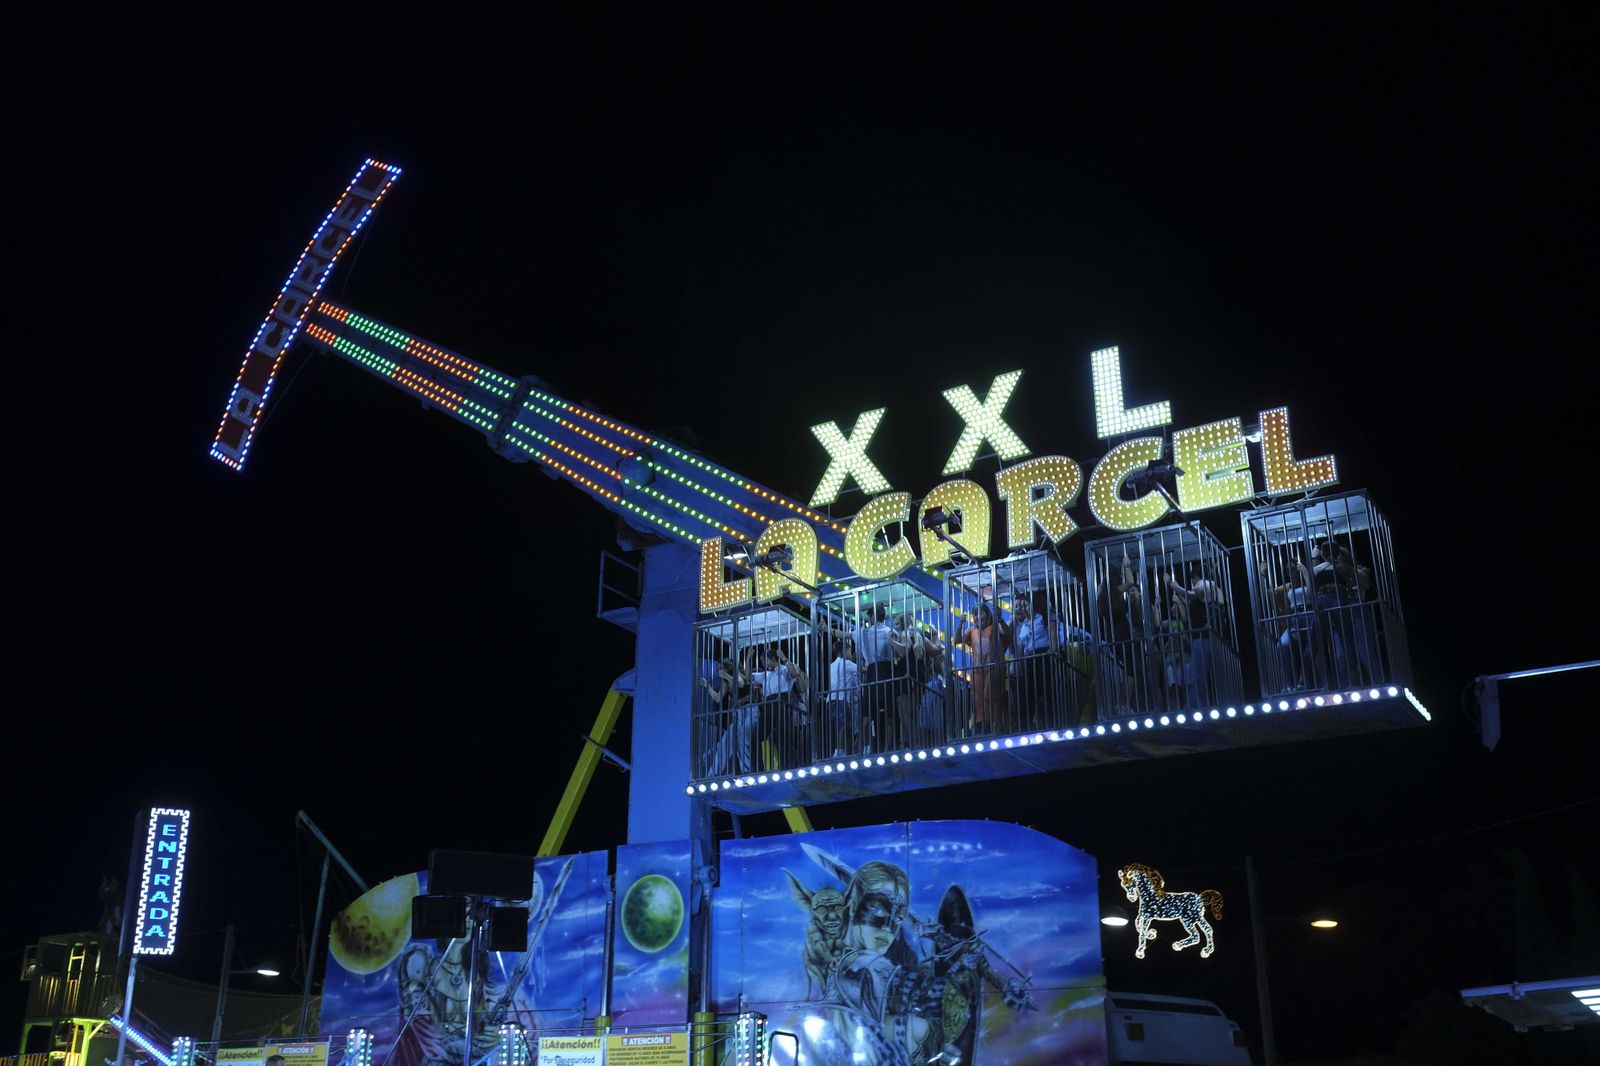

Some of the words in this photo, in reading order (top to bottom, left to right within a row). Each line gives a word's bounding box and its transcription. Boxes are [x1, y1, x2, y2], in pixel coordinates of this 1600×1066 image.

[216, 387, 263, 461] LA
[256, 170, 392, 358] CARCEL
[699, 517, 819, 612] LA
[843, 405, 1338, 581] CARCEL
[144, 824, 178, 938] ENTRADA
